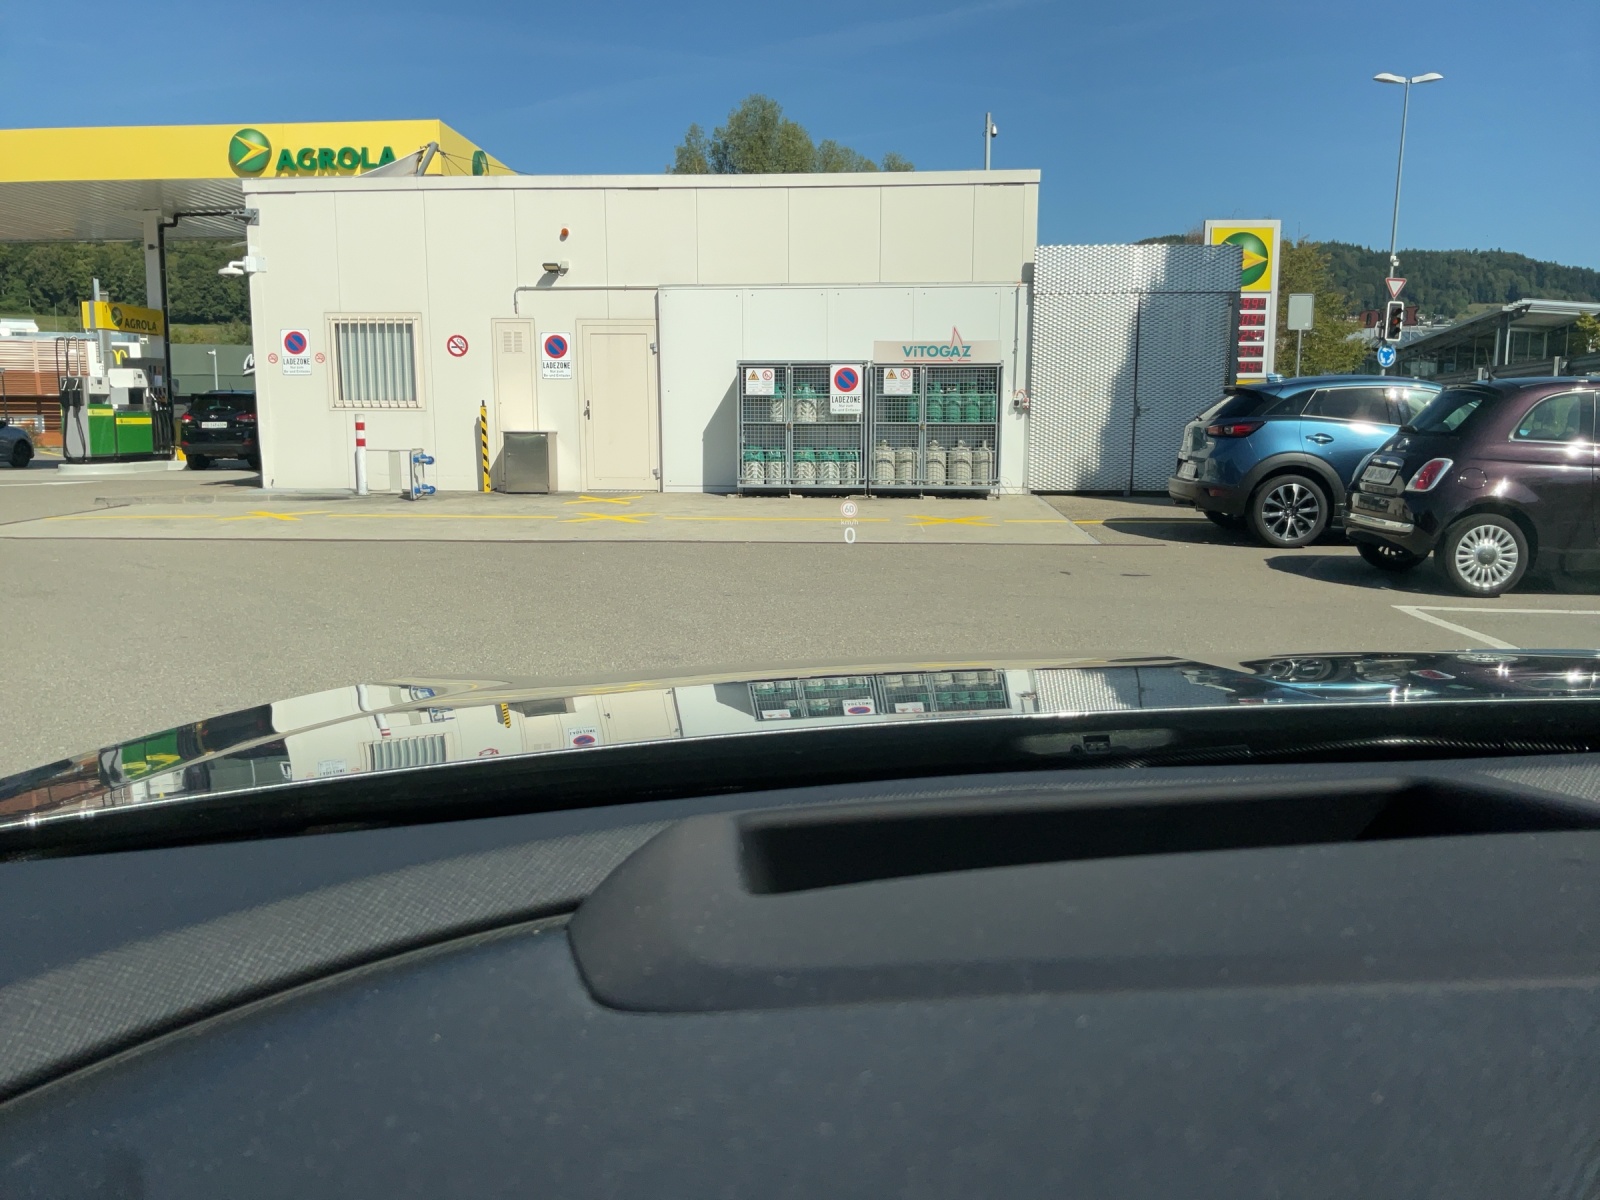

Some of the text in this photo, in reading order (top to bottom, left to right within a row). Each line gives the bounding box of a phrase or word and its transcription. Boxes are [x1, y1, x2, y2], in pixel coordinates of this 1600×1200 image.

[275, 146, 397, 171] AGROLA
[124, 318, 158, 331] AGROLA
[844, 505, 854, 514] 60
[844, 527, 856, 544] 0
